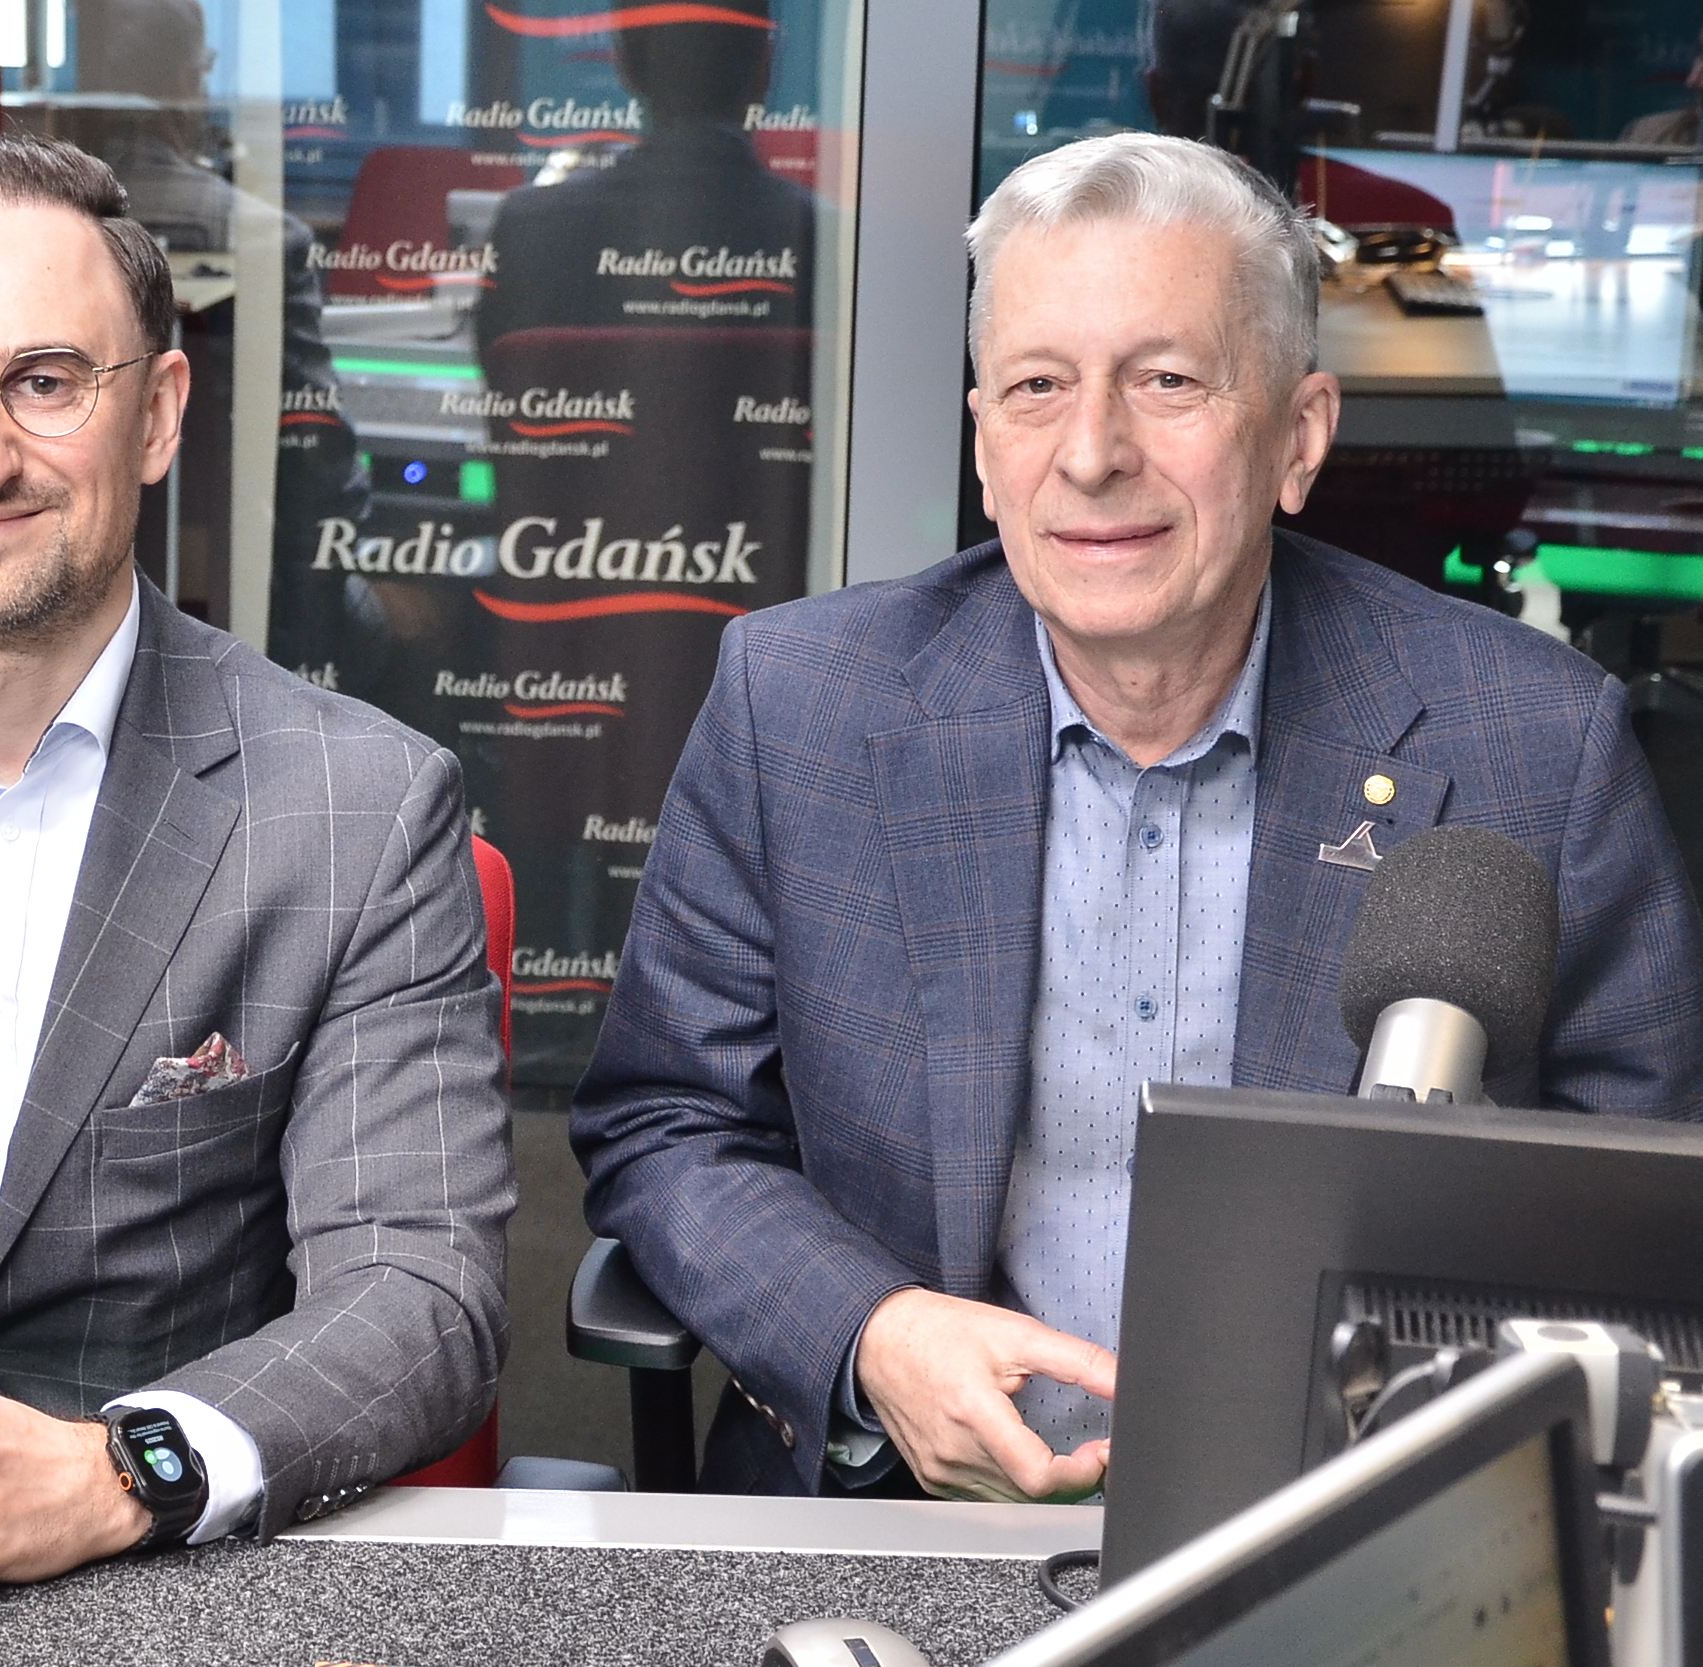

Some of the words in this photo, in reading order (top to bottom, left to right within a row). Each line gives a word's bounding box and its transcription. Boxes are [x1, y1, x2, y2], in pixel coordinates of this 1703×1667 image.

[445, 100, 524, 129] Radio
[527, 97, 645, 131] Gdańsk
[305, 242, 383, 270] Radio
[385, 239, 499, 272] Gdańsk
[597, 247, 677, 277] Radio
[679, 244, 798, 279] Gdańsk
[440, 391, 516, 418] Radio
[519, 387, 638, 421] Gdańsk
[733, 395, 812, 425] Radio
[311, 516, 484, 577] Radio
[498, 515, 764, 585] Gdańsk
[434, 669, 510, 699] Radio
[513, 669, 629, 703] Gdańsk
[582, 813, 657, 844] Radio
[512, 947, 620, 979] Gdańsk
